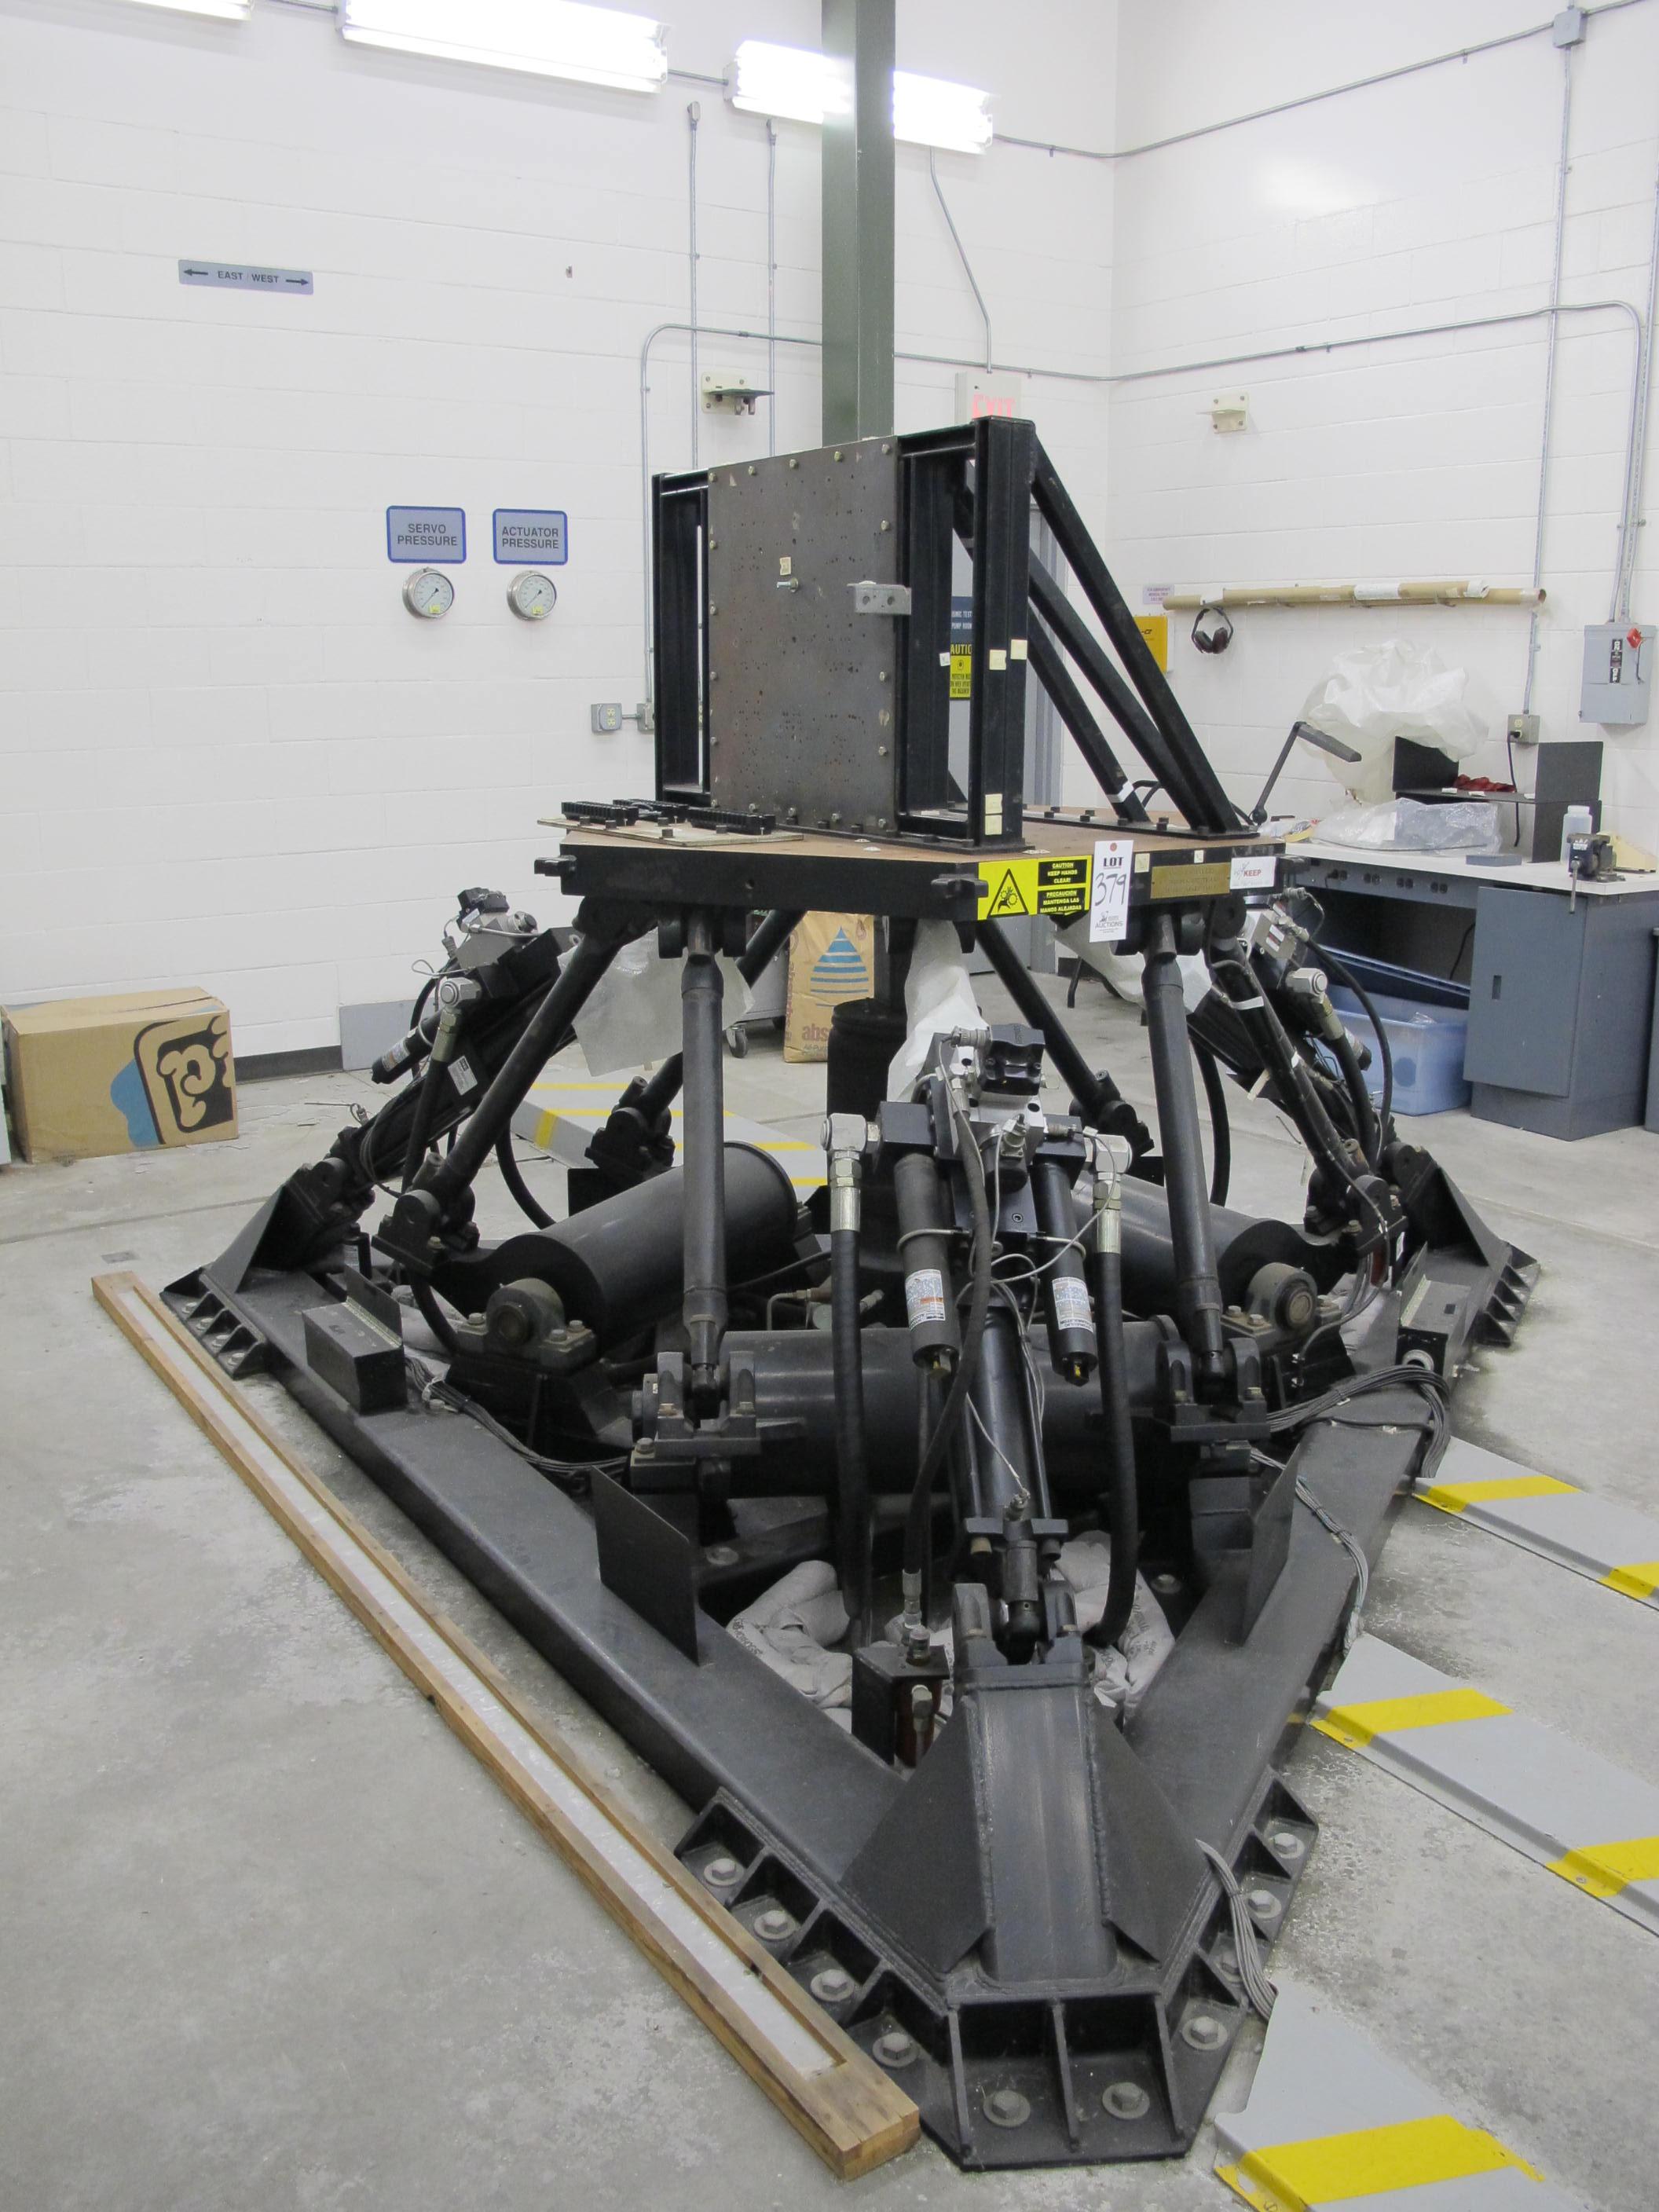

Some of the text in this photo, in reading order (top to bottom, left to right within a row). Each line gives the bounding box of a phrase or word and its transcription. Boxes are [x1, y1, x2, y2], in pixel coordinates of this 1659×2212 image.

[218, 270, 280, 284] EAST WEST
[408, 523, 446, 534] SERVO
[502, 526, 558, 537] ACTUATOR
[397, 535, 457, 546] PRESSURE
[502, 538, 558, 549] PRESSURE
[950, 644, 972, 654] AUTIO
[1104, 856, 1124, 867] LOT
[1243, 869, 1262, 877] KEEP
[1094, 873, 1127, 906] 379
